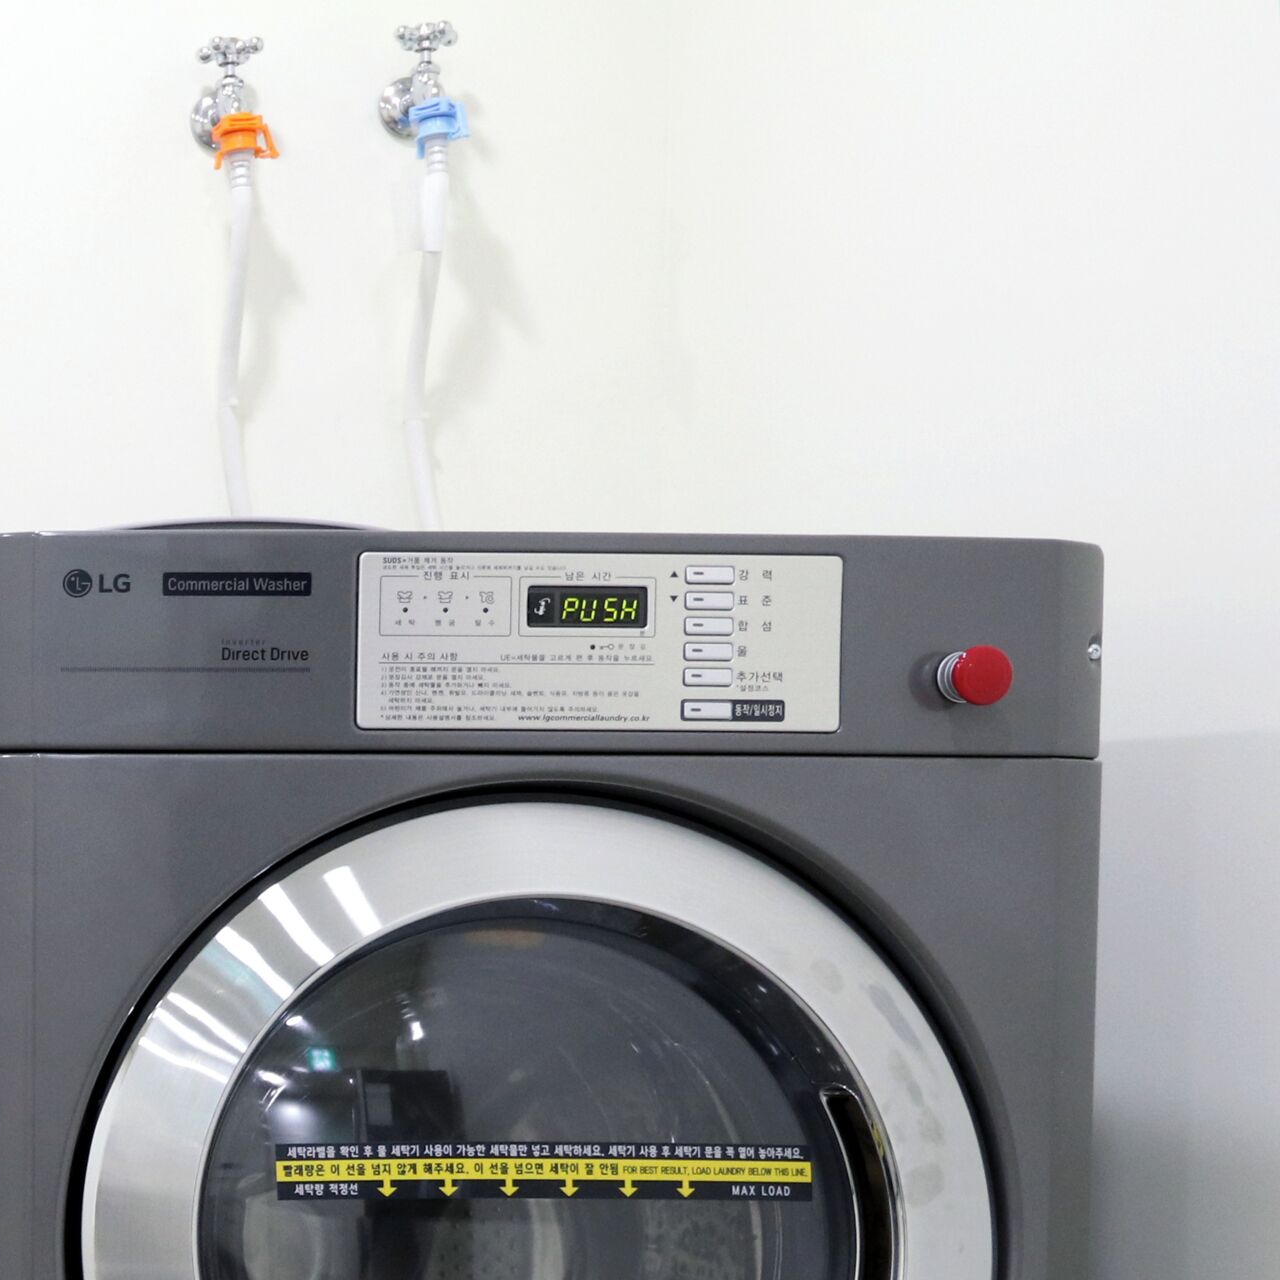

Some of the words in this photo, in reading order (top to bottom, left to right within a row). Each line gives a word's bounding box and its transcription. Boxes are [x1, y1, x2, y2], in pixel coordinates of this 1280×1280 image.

[423, 571, 443, 581] 진행
[450, 572, 470, 581] 표시
[565, 572, 584, 581] 남은
[592, 572, 612, 581] 시간
[99, 574, 131, 593] LG
[167, 577, 249, 591] Commercial
[253, 578, 307, 592] Washer
[562, 597, 638, 622] PUSH
[221, 647, 265, 661] Direct
[270, 647, 309, 661] Drive
[382, 652, 401, 661] 사용
[405, 653, 413, 661] 시
[736, 671, 783, 682] 추가선택
[734, 704, 783, 717] 동작/일시정지
[330, 1164, 339, 1175] 이
[345, 1163, 365, 1175] 선을
[396, 1163, 416, 1175] 않게
[423, 1162, 468, 1174] 해주세요.
[474, 1162, 483, 1174] 이
[489, 1162, 508, 1174] 선을
[549, 1162, 578, 1174] 세탁이
[584, 1163, 593, 1175] 잘
[294, 1183, 323, 1195] 세탁량
[329, 1183, 357, 1195] 적정선
[732, 1185, 755, 1195] MAX
[761, 1185, 790, 1196] LOAD
